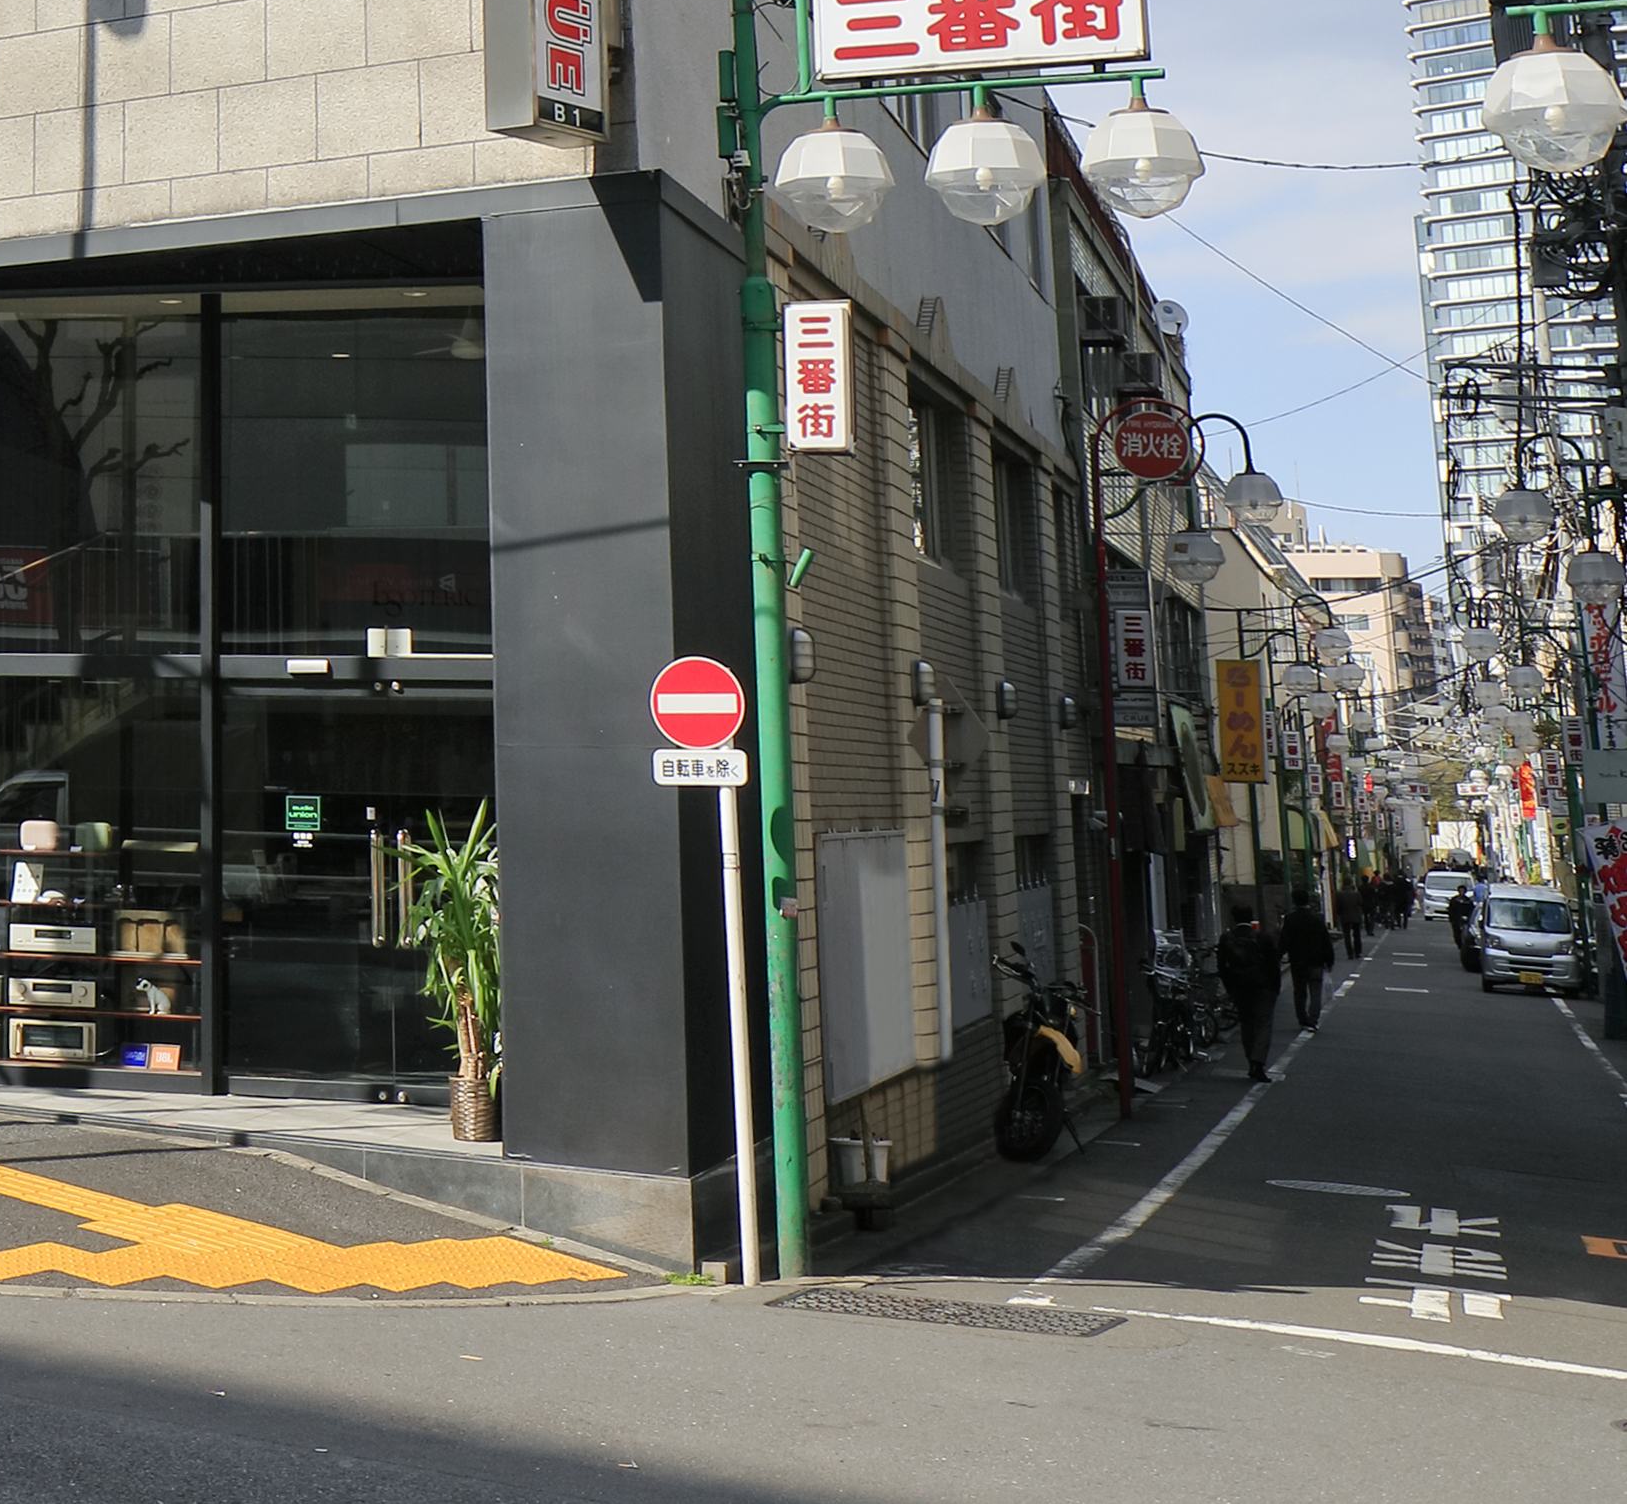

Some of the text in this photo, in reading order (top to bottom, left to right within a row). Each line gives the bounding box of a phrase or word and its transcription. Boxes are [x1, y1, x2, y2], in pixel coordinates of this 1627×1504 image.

[797, 316, 836, 439] 三番街
[1126, 420, 1176, 429] FIRE HYDRANT
[1121, 432, 1183, 459] 消火栓
[1123, 616, 1146, 682] 三番街
[1123, 714, 1150, 722] CRUE
[1225, 666, 1258, 760] らーめん
[662, 758, 739, 778] 自転車を除く
[1226, 762, 1261, 776] スズキ
[289, 811, 318, 819] union
[155, 1051, 174, 1063] JBL
[1358, 1203, 1513, 1324] 止まれ
